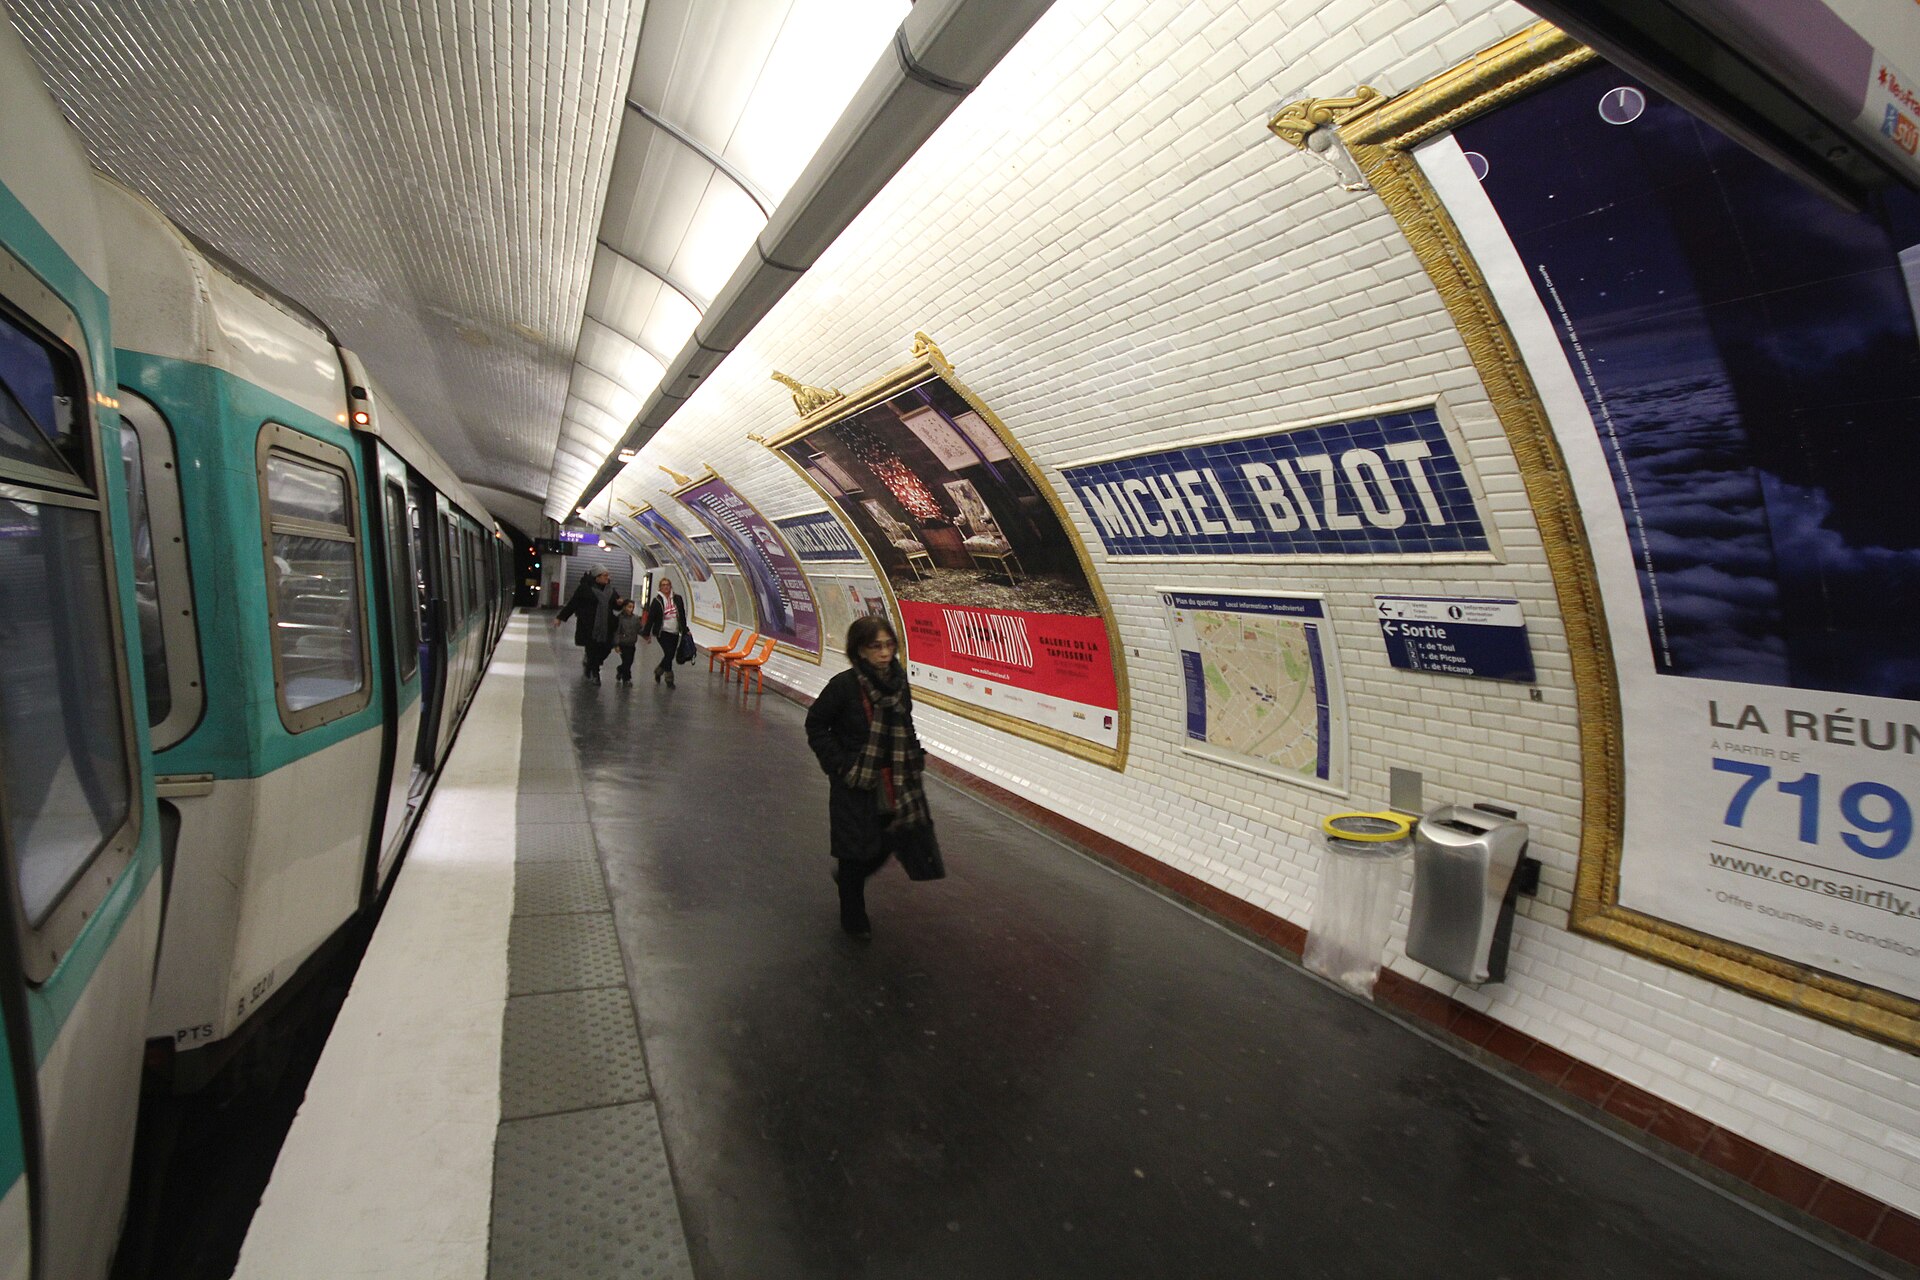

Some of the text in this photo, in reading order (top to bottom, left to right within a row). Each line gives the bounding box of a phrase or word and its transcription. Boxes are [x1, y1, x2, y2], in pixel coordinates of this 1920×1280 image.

[1083, 440, 1446, 539] MICHEL BIZOT
[942, 608, 1034, 668] INSTALLATIONS
[1400, 623, 1447, 639] Sortie
[1039, 636, 1099, 651] GALERIE DE LA
[1426, 643, 1436, 651] de
[1436, 643, 1456, 652] Toul
[1047, 648, 1093, 662] TAPISSERIE
[1439, 654, 1467, 663] Picpus
[1442, 664, 1474, 675] Fécamp
[1709, 700, 1769, 735] LA
[1724, 742, 1775, 760] PARTIR
[1780, 750, 1800, 763] DE
[1712, 757, 1913, 860] 719
[1709, 852, 1920, 917] www.corsairfly.
[1716, 890, 1920, 959] Offre soumise à conditio
[177, 1024, 214, 1043] PTS
